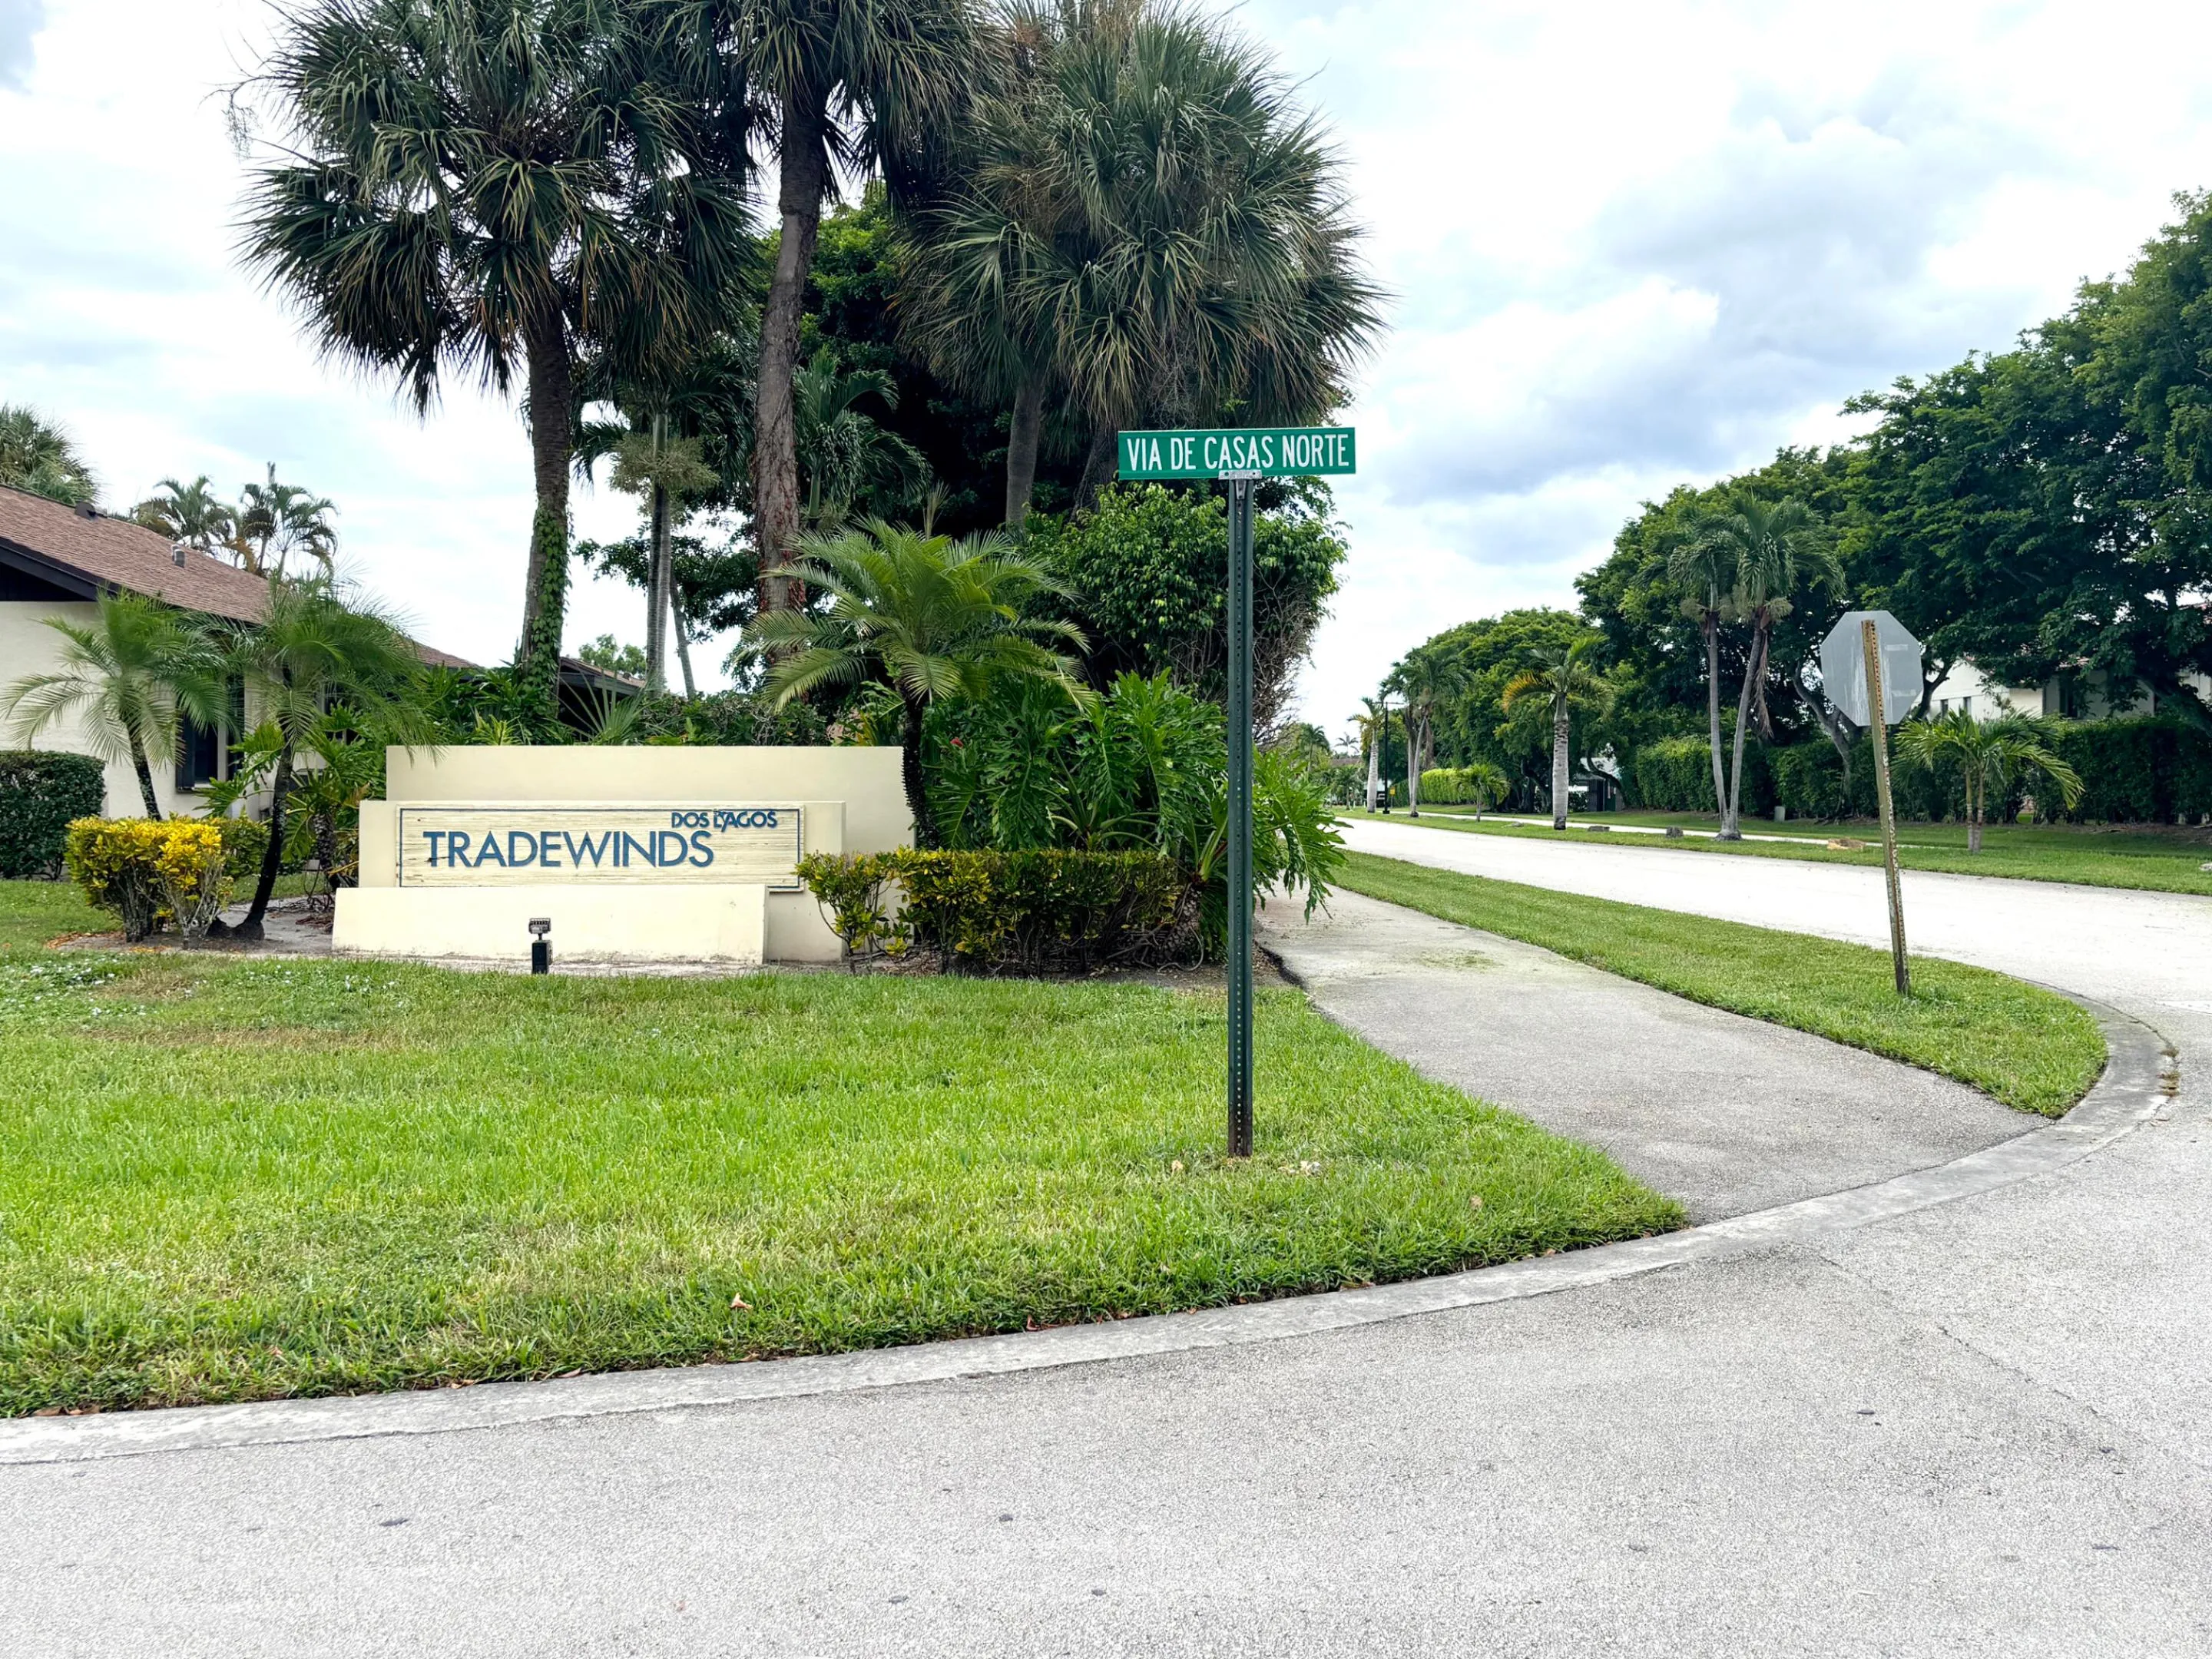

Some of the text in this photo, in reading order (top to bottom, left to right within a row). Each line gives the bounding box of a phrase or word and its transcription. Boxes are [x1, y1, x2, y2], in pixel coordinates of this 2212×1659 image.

[1127, 434, 1349, 471] VIA DE CASAS NORTE
[671, 812, 710, 828] DOS
[422, 830, 715, 868] TRADEWINDS
